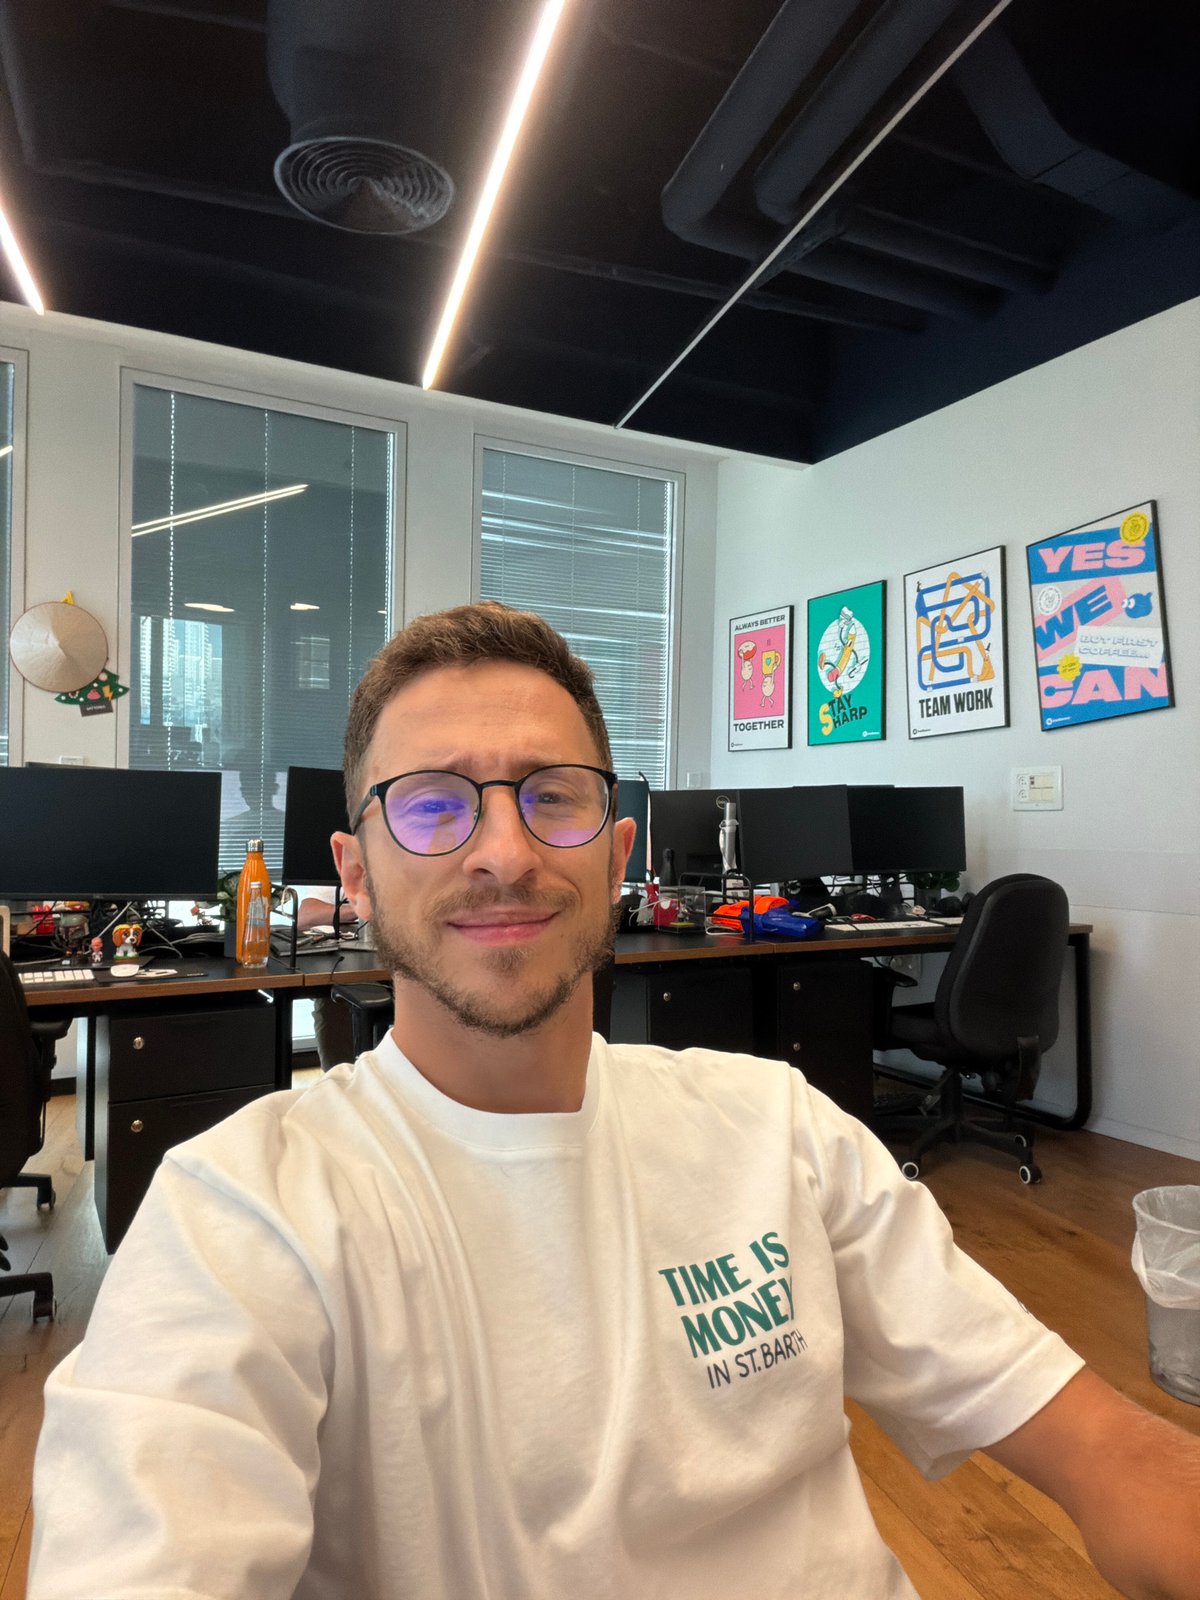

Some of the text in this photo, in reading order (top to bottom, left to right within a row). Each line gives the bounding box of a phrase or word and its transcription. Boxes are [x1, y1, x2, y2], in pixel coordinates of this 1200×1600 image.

[1038, 539, 1146, 573] YES
[735, 615, 785, 631] ALWAYS BETTER
[1034, 585, 1113, 651] WE
[918, 687, 993, 718] TEAM WORK
[1039, 662, 1168, 709] CAN
[733, 719, 785, 732] TOGETHER
[658, 1231, 790, 1306] TIME IS
[681, 1275, 795, 1358] MONEY
[707, 1359, 731, 1389] IN
